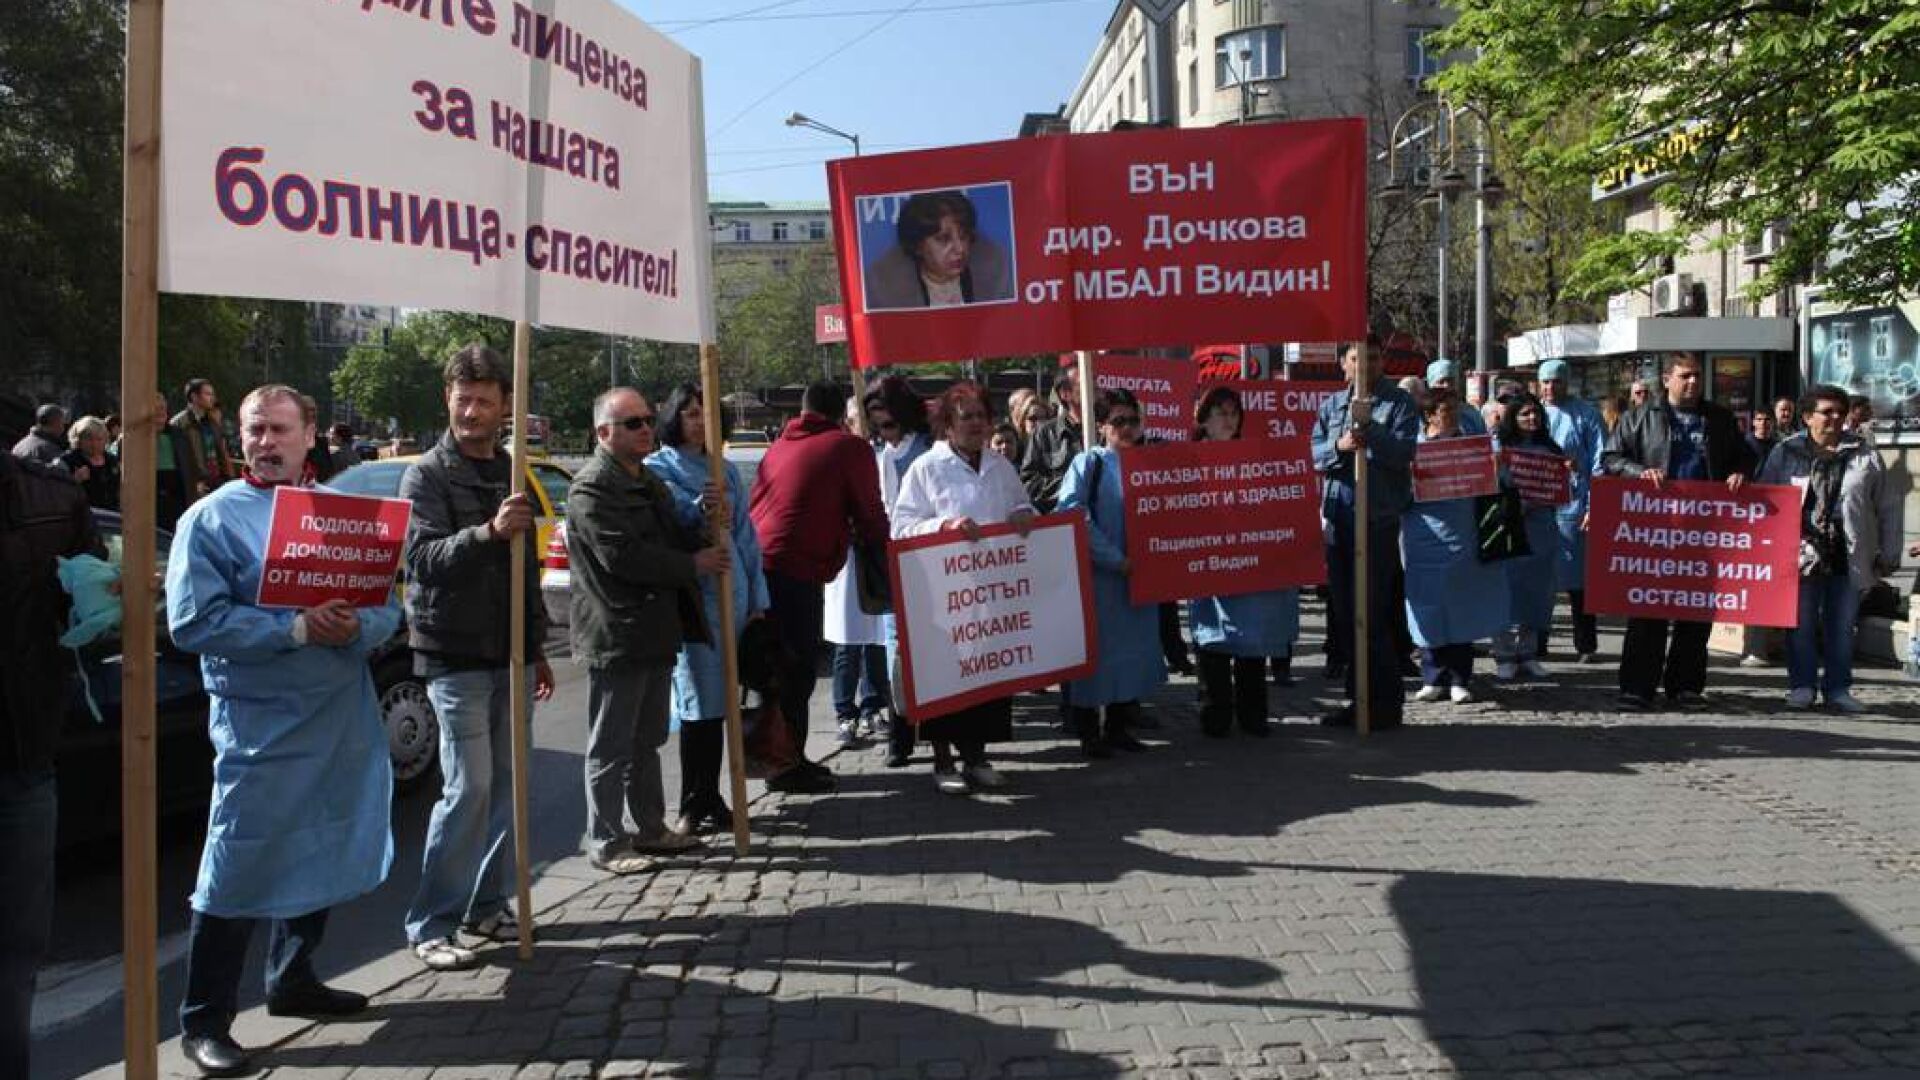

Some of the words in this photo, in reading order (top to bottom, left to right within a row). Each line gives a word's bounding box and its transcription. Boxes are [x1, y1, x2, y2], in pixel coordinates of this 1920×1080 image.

[511, 2, 647, 111] лиценза
[411, 79, 477, 142] за
[491, 99, 620, 190] нашата
[1128, 160, 1215, 194] ВЪН
[1043, 224, 1122, 255] дир.
[1143, 214, 1307, 250] Дочкова
[1025, 279, 1064, 304] от
[1074, 264, 1182, 301] МБАЛ
[1195, 259, 1331, 298] Видин!
[1096, 375, 1171, 393] ОДЛОГАТА
[1267, 419, 1298, 438] ЗА
[1130, 465, 1210, 487] ОТКАЗВАТ
[1214, 464, 1236, 482] НИ
[1240, 459, 1307, 480] ДОСТЪП
[1137, 496, 1161, 515] ДО
[1164, 491, 1218, 512] ЖИВОТ
[1223, 490, 1235, 505] И
[1239, 485, 1306, 506] ЗДРАВЕ!
[1622, 491, 1767, 524] Министър
[301, 515, 389, 537] ПОДЛОГАТА
[1150, 533, 1222, 554] Пациенти
[1226, 533, 1237, 546] и
[1240, 527, 1295, 546] лекари
[1614, 521, 1752, 550] Андреева
[282, 541, 363, 562] ДОЧКОВА
[366, 550, 392, 563] ВЪН
[944, 545, 1028, 576] ИСКАМЕ
[1188, 558, 1204, 573] от
[1208, 554, 1259, 574] Видин
[267, 569, 296, 584] ОТ
[298, 571, 346, 588] МБАЛ
[1609, 554, 1709, 578] лиценз
[1717, 561, 1772, 580] или
[948, 578, 1031, 615] ДОСТЪП
[1627, 587, 1748, 611] оставка!
[952, 611, 1033, 645] ИСКАМЕ
[959, 644, 1035, 679] ЖИВОТ!
